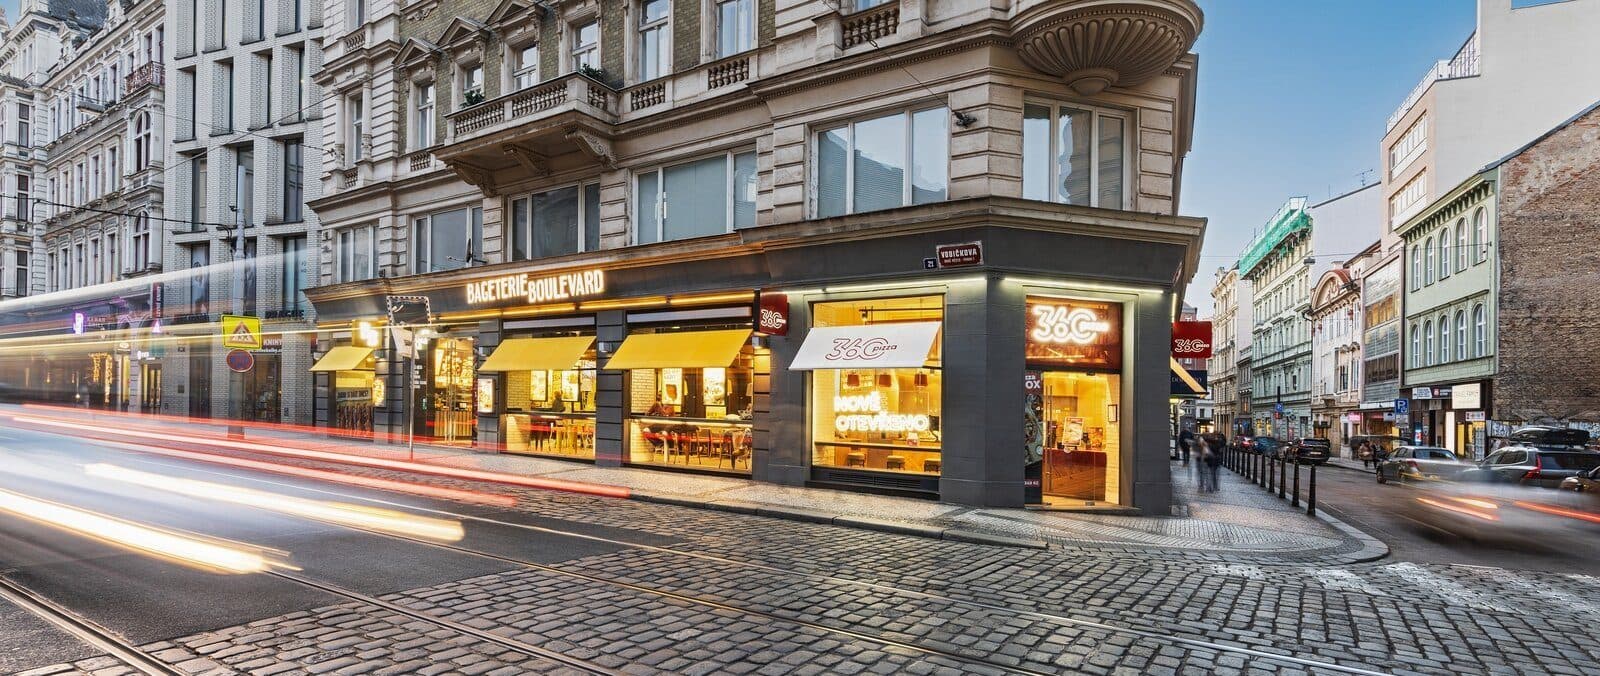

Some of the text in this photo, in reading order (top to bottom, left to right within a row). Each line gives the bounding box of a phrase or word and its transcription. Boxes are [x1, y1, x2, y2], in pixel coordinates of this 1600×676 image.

[466, 270, 604, 304] BAGETERIE BOULEVARD
[872, 344, 898, 353] pizza
[1025, 380, 1040, 389] OX
[1397, 400, 1406, 410] P
